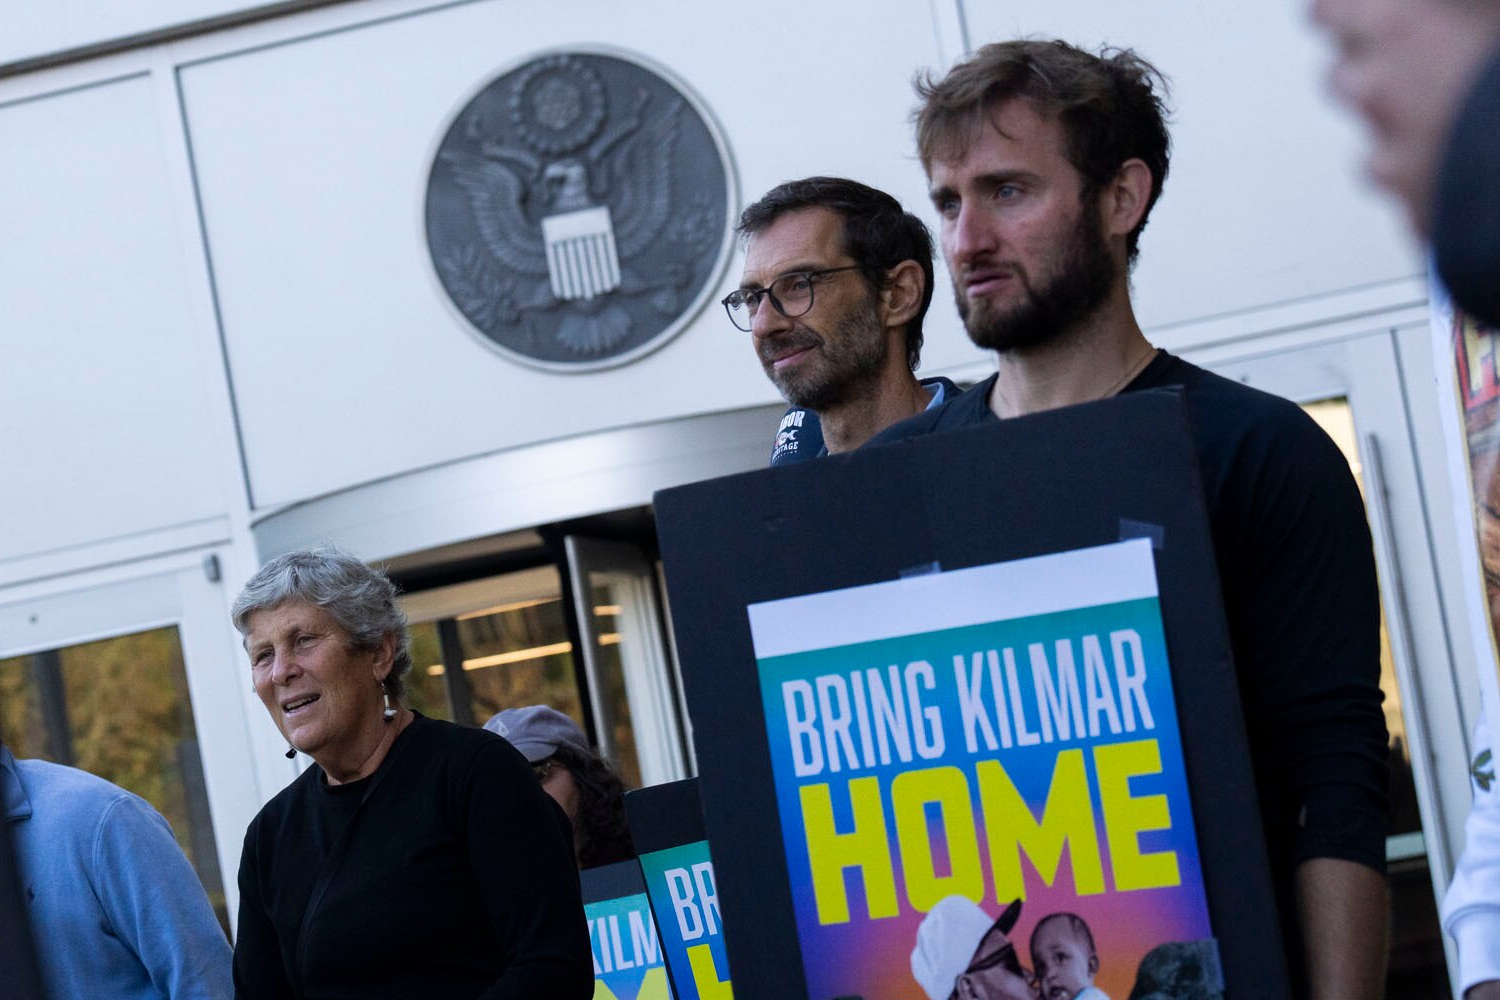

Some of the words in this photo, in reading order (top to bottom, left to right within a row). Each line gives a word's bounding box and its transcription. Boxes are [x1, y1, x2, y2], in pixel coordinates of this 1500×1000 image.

[782, 660, 946, 777] BRING
[953, 628, 1155, 753] KILMAR
[799, 738, 1181, 925] HOME
